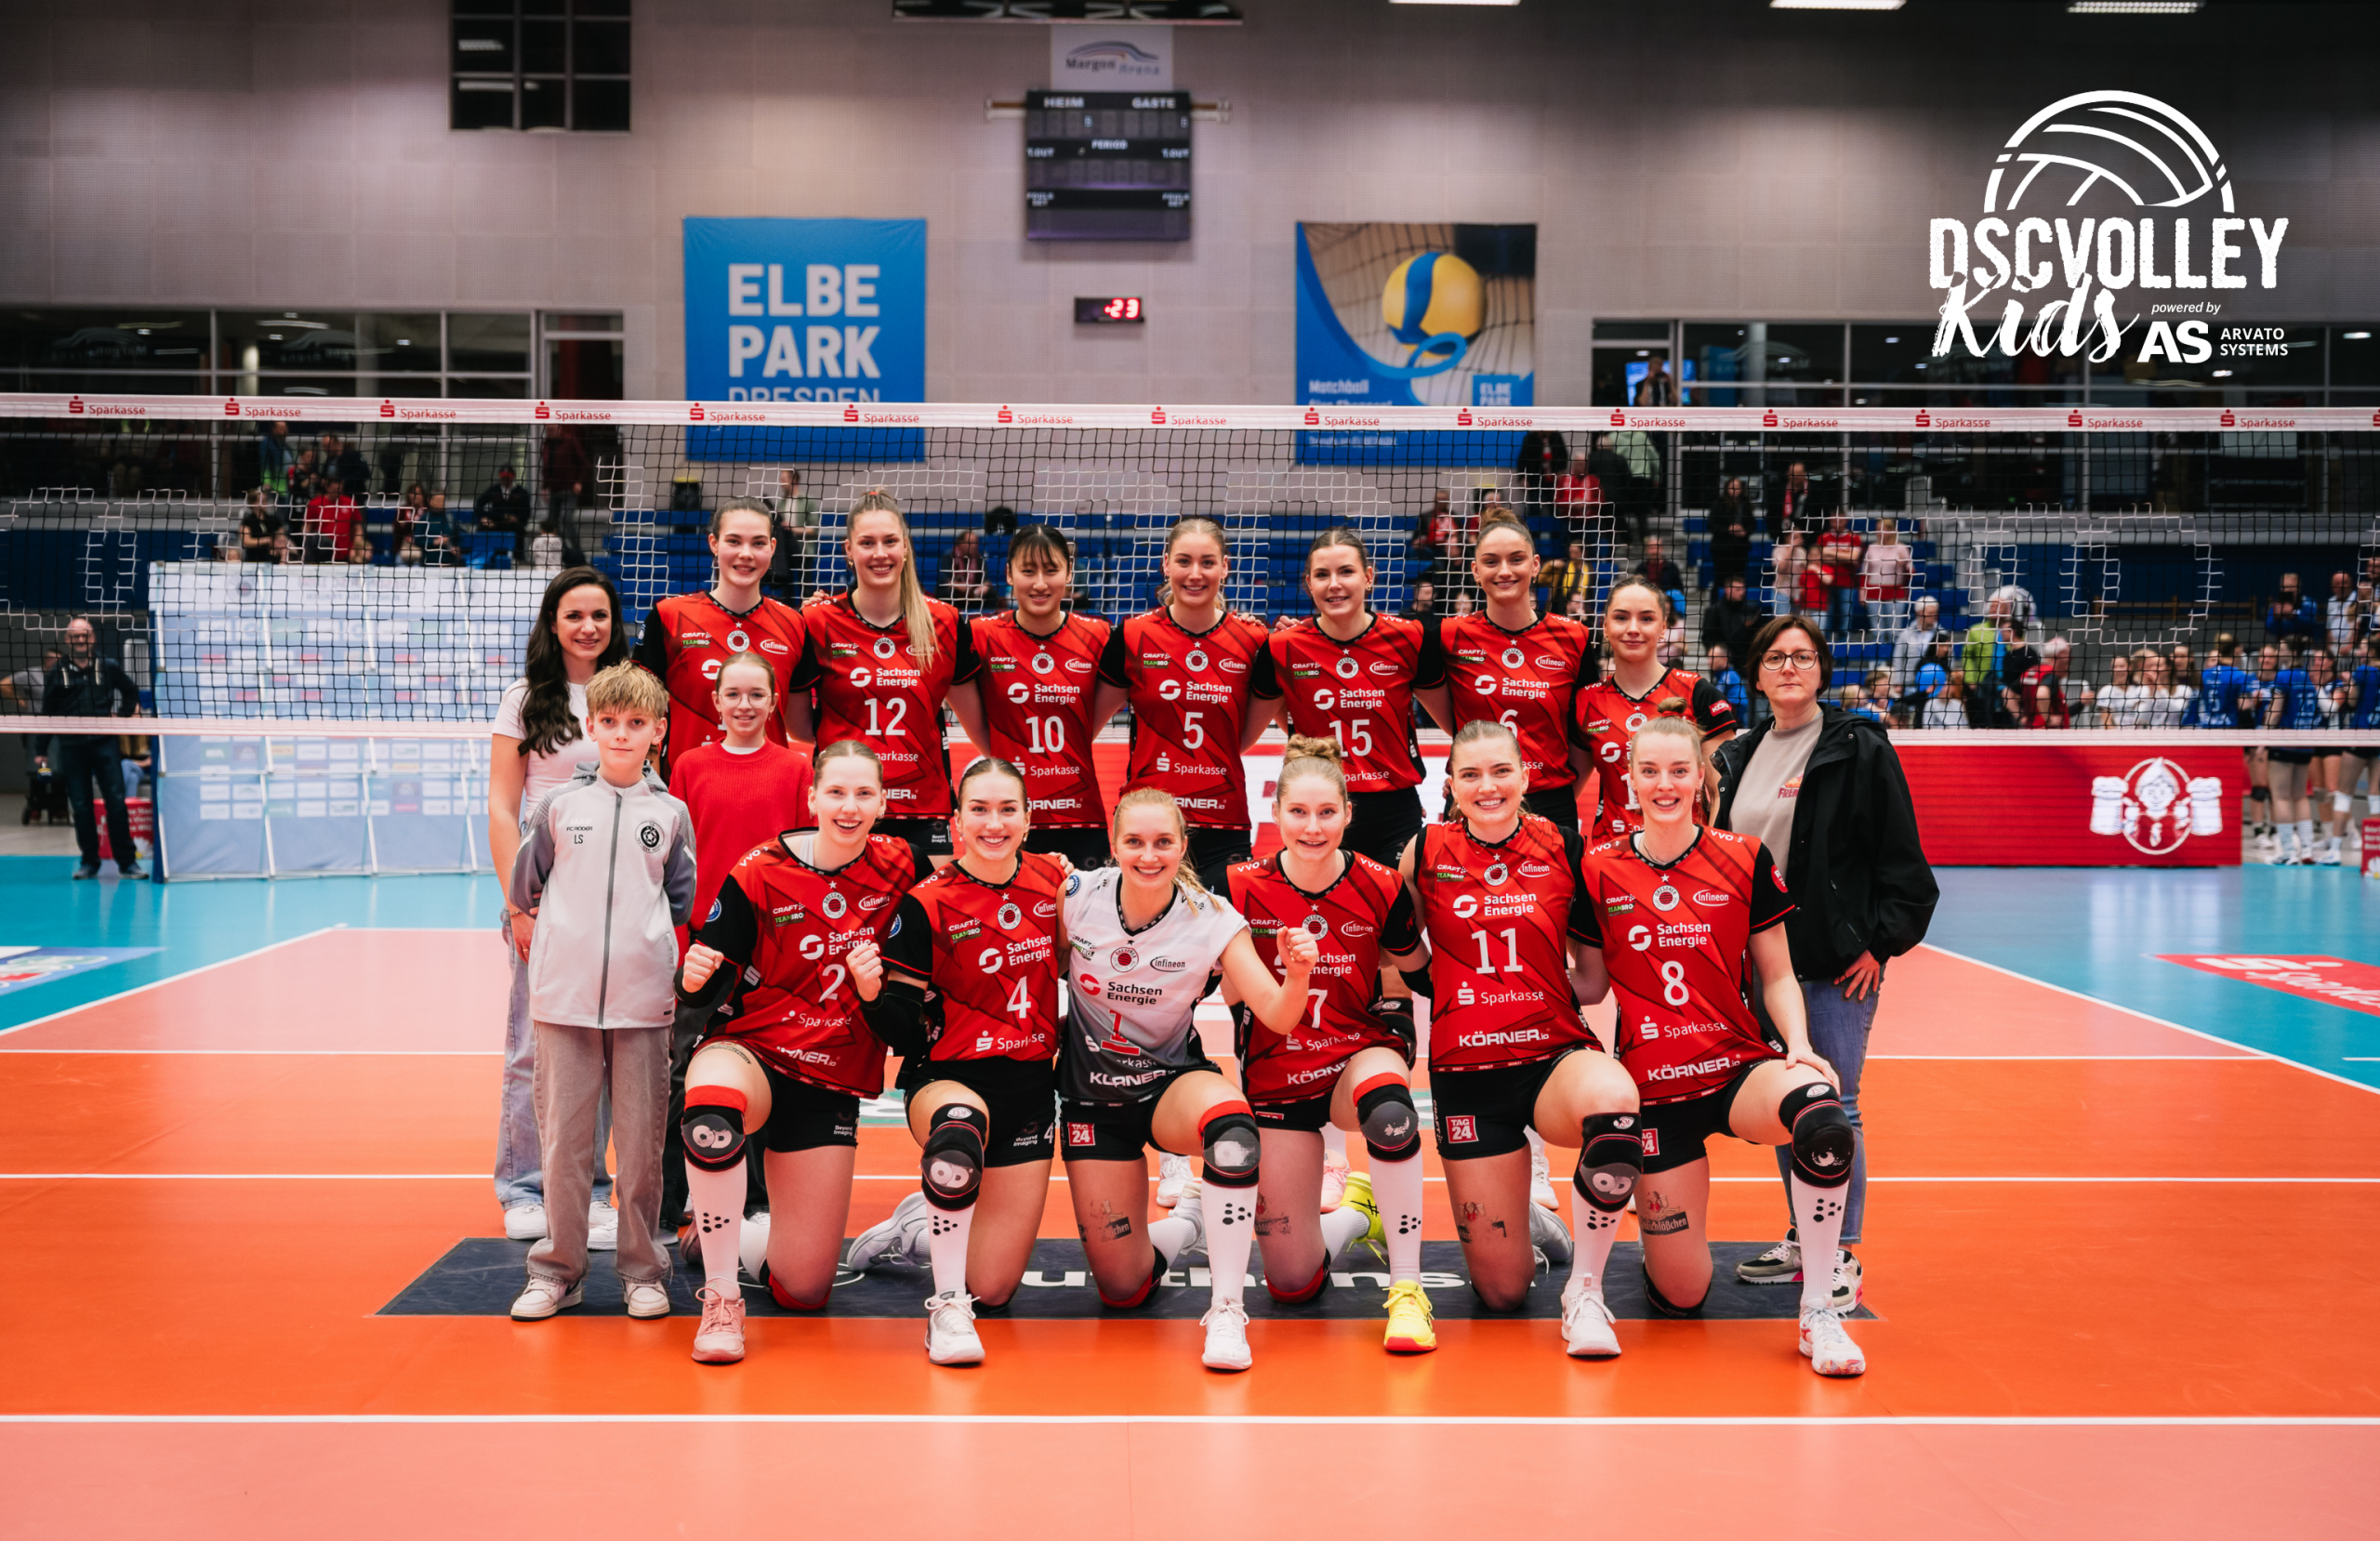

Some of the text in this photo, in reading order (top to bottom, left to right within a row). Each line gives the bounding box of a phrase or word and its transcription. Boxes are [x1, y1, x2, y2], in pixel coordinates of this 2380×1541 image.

[1065, 59, 1115, 72] Margon
[1044, 98, 1084, 108] HEIM
[729, 263, 880, 317] ELBE
[729, 325, 881, 378] PARK
[729, 387, 879, 402] DRESDEN
[89, 405, 145, 415] Sparkasse
[245, 406, 301, 417] Sparkasse
[400, 408, 456, 419] Sparkasse
[555, 410, 611, 421] Sparkasse
[709, 412, 765, 423] Sparkasse
[864, 413, 919, 425] Sparkasse
[1017, 414, 1073, 425] Sparkasse
[1171, 415, 1227, 427] Sparkasse
[1324, 415, 1380, 428] Sparkasse
[1477, 416, 1533, 428] Sparkasse
[1630, 417, 1686, 428] Sparkasse
[1782, 417, 1838, 429] Sparkasse
[1936, 417, 1990, 429] Sparkasse
[2087, 417, 2143, 429] Sparkasse
[2240, 417, 2295, 429] Sparkasse
[877, 668, 920, 677] Sachsen
[877, 678, 918, 688] Energie
[1035, 684, 1079, 693] Sachsen
[1186, 681, 1232, 693] Sachsen
[1502, 678, 1550, 689] Sachsen
[1186, 691, 1228, 704] Energie
[1340, 689, 1385, 698] Sachsen
[1502, 687, 1546, 699] Energie
[1035, 694, 1076, 705] Energie
[1341, 699, 1382, 709] Energie
[865, 697, 906, 736] 12
[1500, 709, 1518, 738] 6
[1025, 716, 1064, 754] 10
[1183, 712, 1204, 749] 5
[1329, 719, 1372, 757] 15
[876, 751, 919, 761] parkasse
[1030, 765, 1079, 778] Sparkasse
[1174, 763, 1226, 775] Sparkasse
[1344, 770, 1389, 782] parkasse
[886, 789, 917, 799] NER.io
[1173, 797, 1225, 810] RNER.io
[575, 835, 583, 844] LS
[1711, 830, 1734, 841] VVO
[1590, 843, 1611, 855] VVO
[739, 849, 761, 867] VVO
[1237, 862, 1260, 872] VVO
[1360, 858, 1382, 871] VVO
[1437, 864, 1461, 873] CRAFT
[918, 875, 939, 889] VVO
[1485, 893, 1537, 904] Sachsen
[773, 904, 799, 915] CRAFT
[1485, 904, 1534, 916] Energie
[948, 920, 973, 931] CRAFT
[1657, 922, 1711, 935] Sachsen
[1006, 935, 1051, 954] Sachsen
[1659, 935, 1707, 948] Energie
[1009, 948, 1051, 966] Energie
[1471, 929, 1523, 974] 11
[1318, 953, 1355, 963] chsen
[1309, 964, 1352, 977] nergie
[818, 964, 846, 1003] 2
[1108, 981, 1162, 996] Sachsen
[1661, 960, 1689, 1006] 8
[1007, 976, 1031, 1019] 4
[1107, 992, 1157, 1006] Energie
[1481, 990, 1544, 1006] Sparkasse
[1308, 988, 1328, 1028] 7
[1101, 1008, 1140, 1056] 1
[1664, 1022, 1727, 1039] Sparkasse
[1450, 1118, 1470, 1126] TAG
[1044, 1123, 1053, 1143] 4
[1073, 1131, 1091, 1142] 24
[1452, 1126, 1472, 1140] 24
